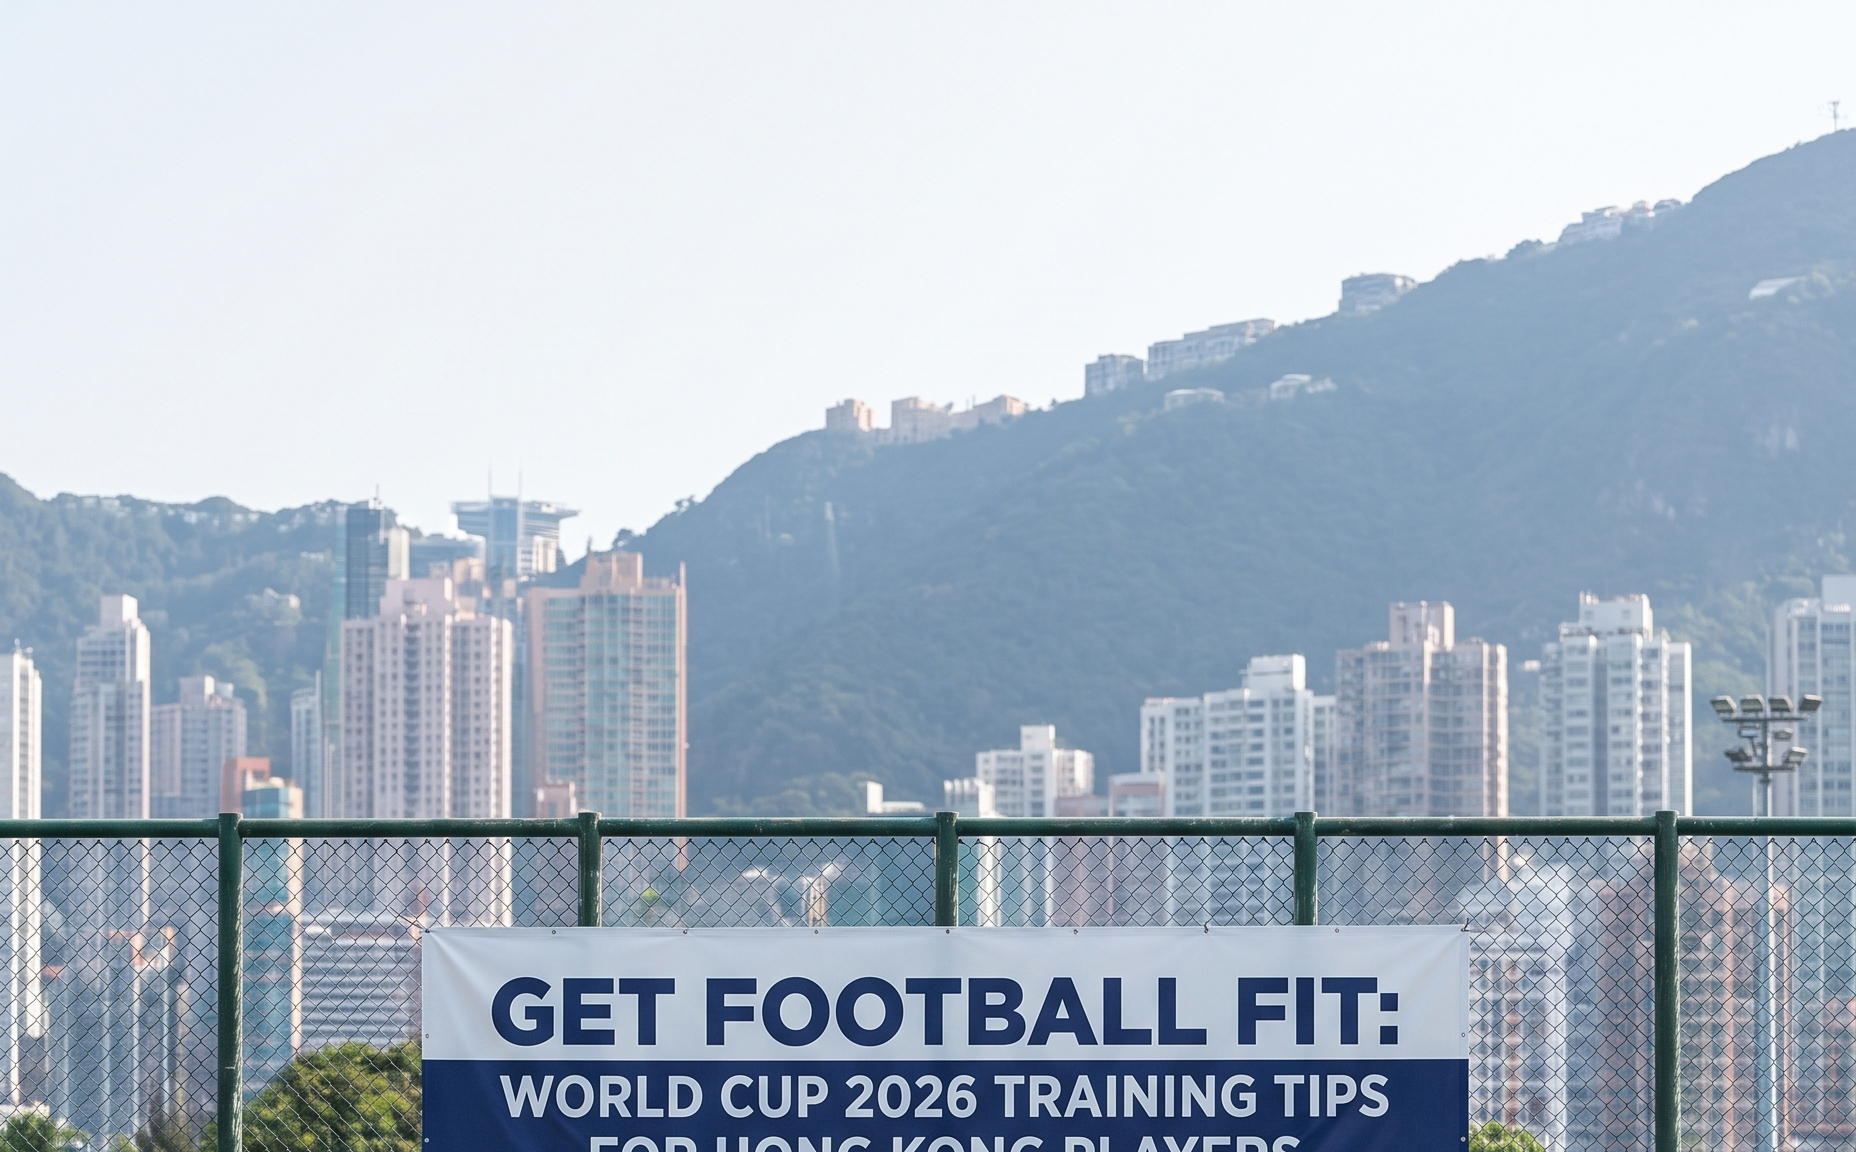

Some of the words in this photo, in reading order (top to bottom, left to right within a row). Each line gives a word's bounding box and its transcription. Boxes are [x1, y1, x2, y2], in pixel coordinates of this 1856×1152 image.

[491, 976, 675, 1047] GET
[706, 976, 1207, 1047] FOOTBALL
[1237, 976, 1399, 1046] FIT:
[499, 1074, 703, 1118] WORLD
[720, 1074, 829, 1119] CUP
[845, 1074, 977, 1119] 2026
[994, 1074, 1257, 1118] TRAINING
[1273, 1073, 1389, 1118] TIPS
